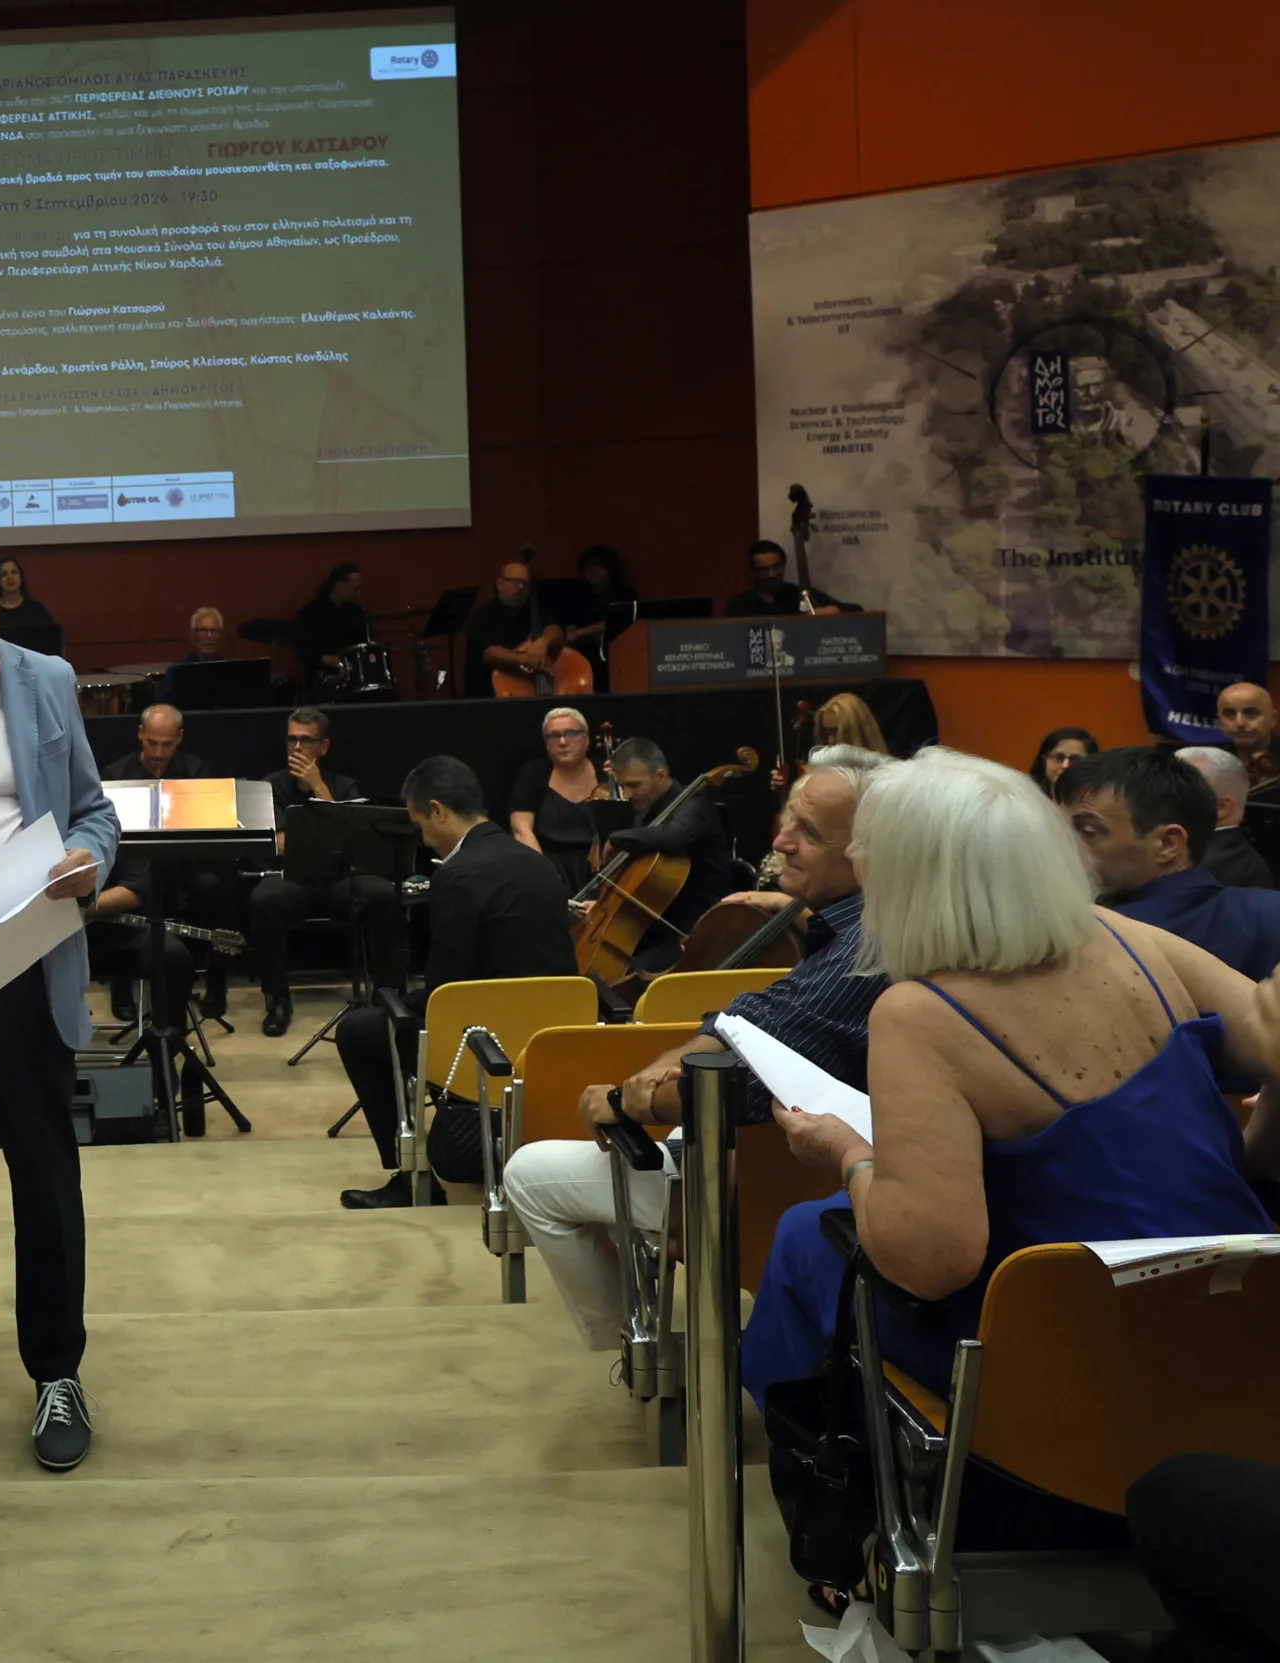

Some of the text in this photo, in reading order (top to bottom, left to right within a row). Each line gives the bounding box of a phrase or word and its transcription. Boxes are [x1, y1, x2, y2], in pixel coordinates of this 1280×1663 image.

[391, 55, 419, 65] Rotary
[57, 71, 111, 87] ΟΜΙΛΟΣ
[115, 70, 153, 84] ΑΓΙΑΣ
[158, 66, 249, 82] ΠΑΡΑΣΚΕΥΗΣ
[75, 90, 145, 104] ΠΕΡΙΦΕΡΕΙΑΣ
[148, 88, 204, 100] ΔΙΕΘΝΟΥΣ
[207, 85, 249, 98] ΡΟΤΑΡΥ
[48, 110, 96, 122] ΑΤΤΙΚΗΣ,
[59, 150, 110, 166] ΠΡΟΣ
[116, 146, 172, 162] ΤΙΜΗΝ
[208, 140, 286, 158] ΓΙΩΡΓΟΥ
[292, 134, 388, 153] ΚΑΤΣΑΡΟΥ
[25, 171, 63, 186] βραδιά
[66, 172, 92, 183] προς
[94, 168, 122, 182] τιμήν
[125, 170, 144, 179] του
[147, 165, 203, 179] σπουδαίου
[206, 161, 293, 176] μουσικοσυνθέτη
[295, 162, 312, 171] και
[315, 157, 390, 171] σαξοφωνίστα.
[23, 199, 31, 210] 9
[36, 193, 127, 211] Σεπτεμβρίου
[132, 192, 168, 205] 2026
[180, 189, 218, 203] 19:30
[73, 231, 91, 241] για
[94, 230, 107, 241] τη
[109, 225, 158, 238] συνολική
[161, 222, 220, 237] προσφορά
[222, 224, 242, 233] του
[245, 223, 270, 233] στον
[272, 217, 320, 231] ελληνικό
[322, 214, 376, 229] πολιτισμό
[379, 216, 397, 226] και
[399, 215, 412, 226] τη
[20, 249, 39, 259] του
[42, 245, 90, 259] συμβολή
[92, 247, 112, 256] στα
[115, 242, 161, 255] Μουσικά
[164, 240, 204, 253] Σύνολα
[206, 240, 226, 250] του
[228, 237, 264, 250] Δήμου
[266, 233, 322, 248] Αθηναίων,
[325, 236, 340, 246] ως
[7, 261, 89, 276] Περιφερειάρχη
[92, 258, 133, 272] Αττικής
[135, 258, 166, 270] Νίκου
[169, 256, 225, 270] Χαρδαλιά.
[48, 308, 67, 317] του
[68, 305, 111, 318] Γιώργου
[112, 301, 165, 314] Κατσαρού
[814, 296, 873, 311] Informatics
[301, 311, 360, 323] Ελευθέριος
[362, 308, 417, 321] Καλκάνης.
[786, 306, 903, 326] & Telecommunications
[1, 363, 59, 376] Δενάρδου,
[61, 360, 108, 374] Χριστίνα
[111, 358, 148, 372] Ράλλη,
[150, 357, 190, 370] Σπύρος
[193, 355, 248, 367] Κλείσσας,
[250, 352, 293, 365] Κώστας
[295, 349, 349, 363] Κονδύλης
[1034, 356, 1061, 377] ΔΗ
[1034, 377, 1064, 397] ΜΟ
[1037, 390, 1064, 411] ΚΡΙ
[1035, 407, 1066, 429] ΤΟΣ
[806, 432, 841, 443] Energy
[854, 427, 890, 440] Safety
[1152, 500, 1263, 517] ROTARY CLUB
[823, 522, 890, 535] Applications
[998, 546, 1144, 568] The Institut
[821, 636, 858, 646] NATIONAL
[848, 645, 863, 654] FOR
[1167, 709, 1224, 730] HELLA
